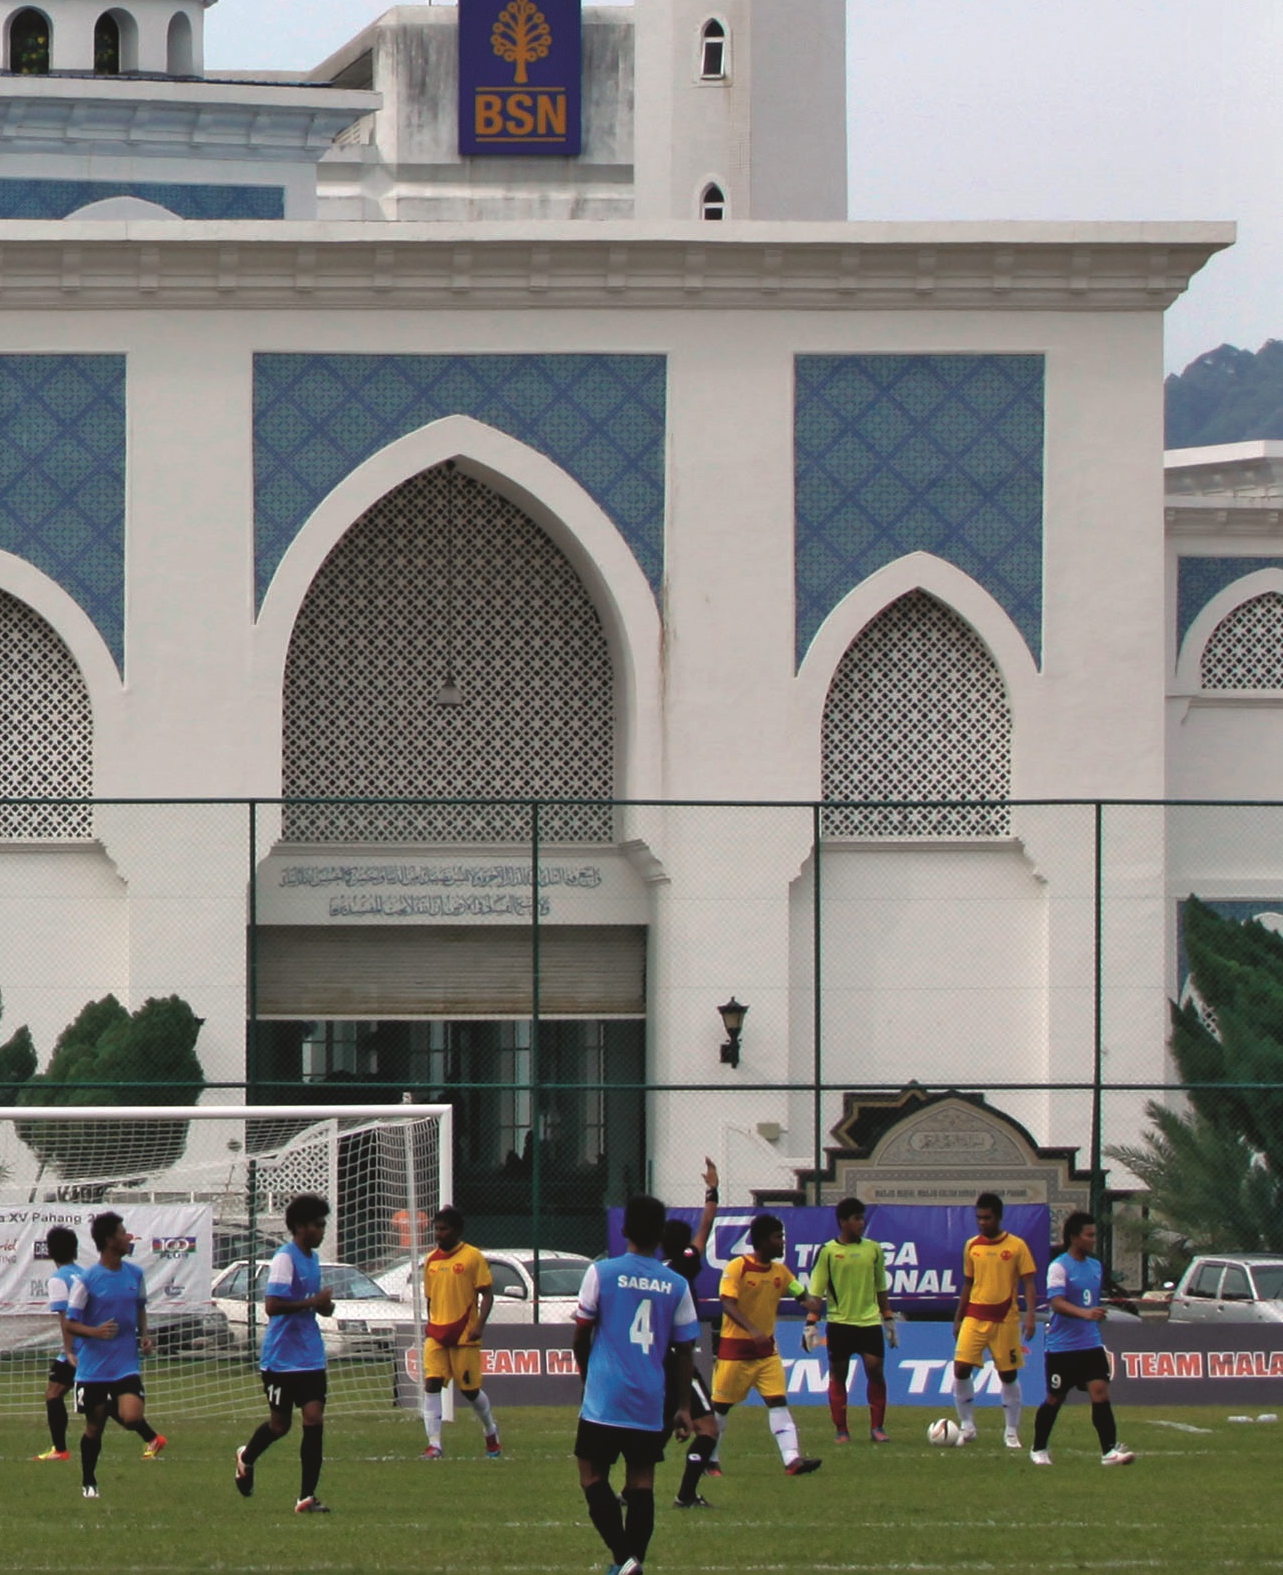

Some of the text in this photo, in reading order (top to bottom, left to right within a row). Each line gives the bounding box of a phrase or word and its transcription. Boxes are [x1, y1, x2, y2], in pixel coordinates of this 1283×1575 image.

[475, 93, 567, 136] BSN
[9, 1212, 28, 1223] XV
[33, 1212, 82, 1226] Pahang
[159, 1238, 190, 1253] 100
[617, 1275, 672, 1295] SABAH
[1083, 1288, 1092, 1306] 9
[629, 1299, 654, 1354] 4
[1009, 1348, 1017, 1364] 5
[1122, 1351, 1203, 1378] TEAM
[1051, 1373, 1062, 1389] 9
[267, 1383, 282, 1406] 11
